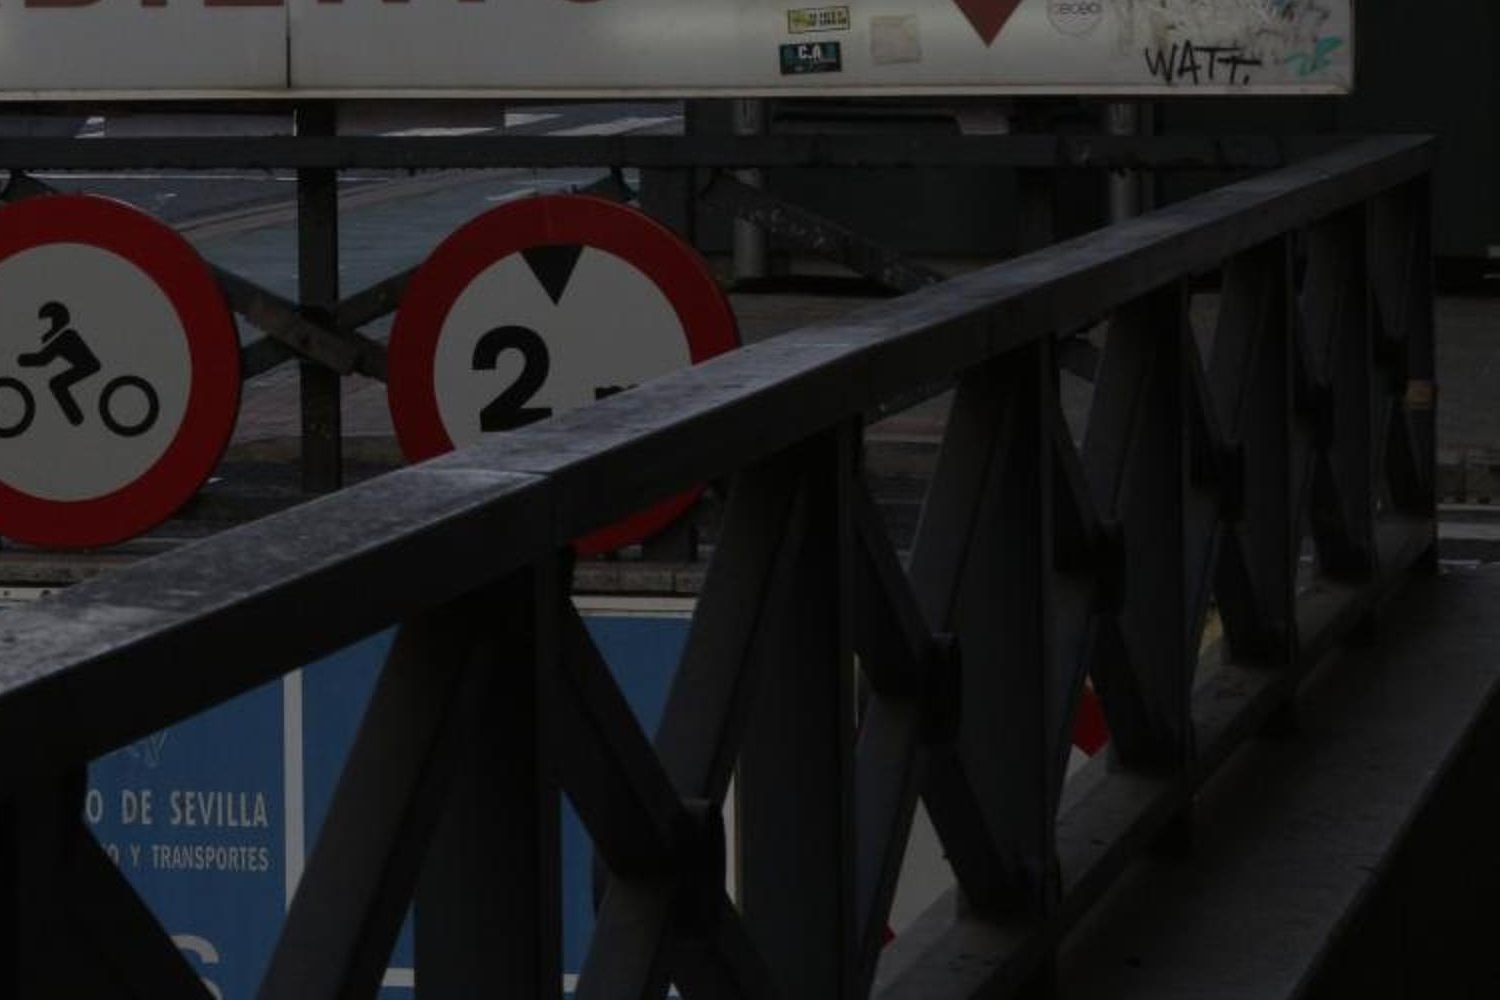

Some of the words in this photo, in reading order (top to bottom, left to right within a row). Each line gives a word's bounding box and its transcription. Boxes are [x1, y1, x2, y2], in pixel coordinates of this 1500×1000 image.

[472, 323, 553, 434] 2
[121, 789, 153, 826] DE
[169, 790, 270, 828] SEVILLA
[129, 844, 142, 867] Y
[151, 844, 270, 872] TRANSPORTES
